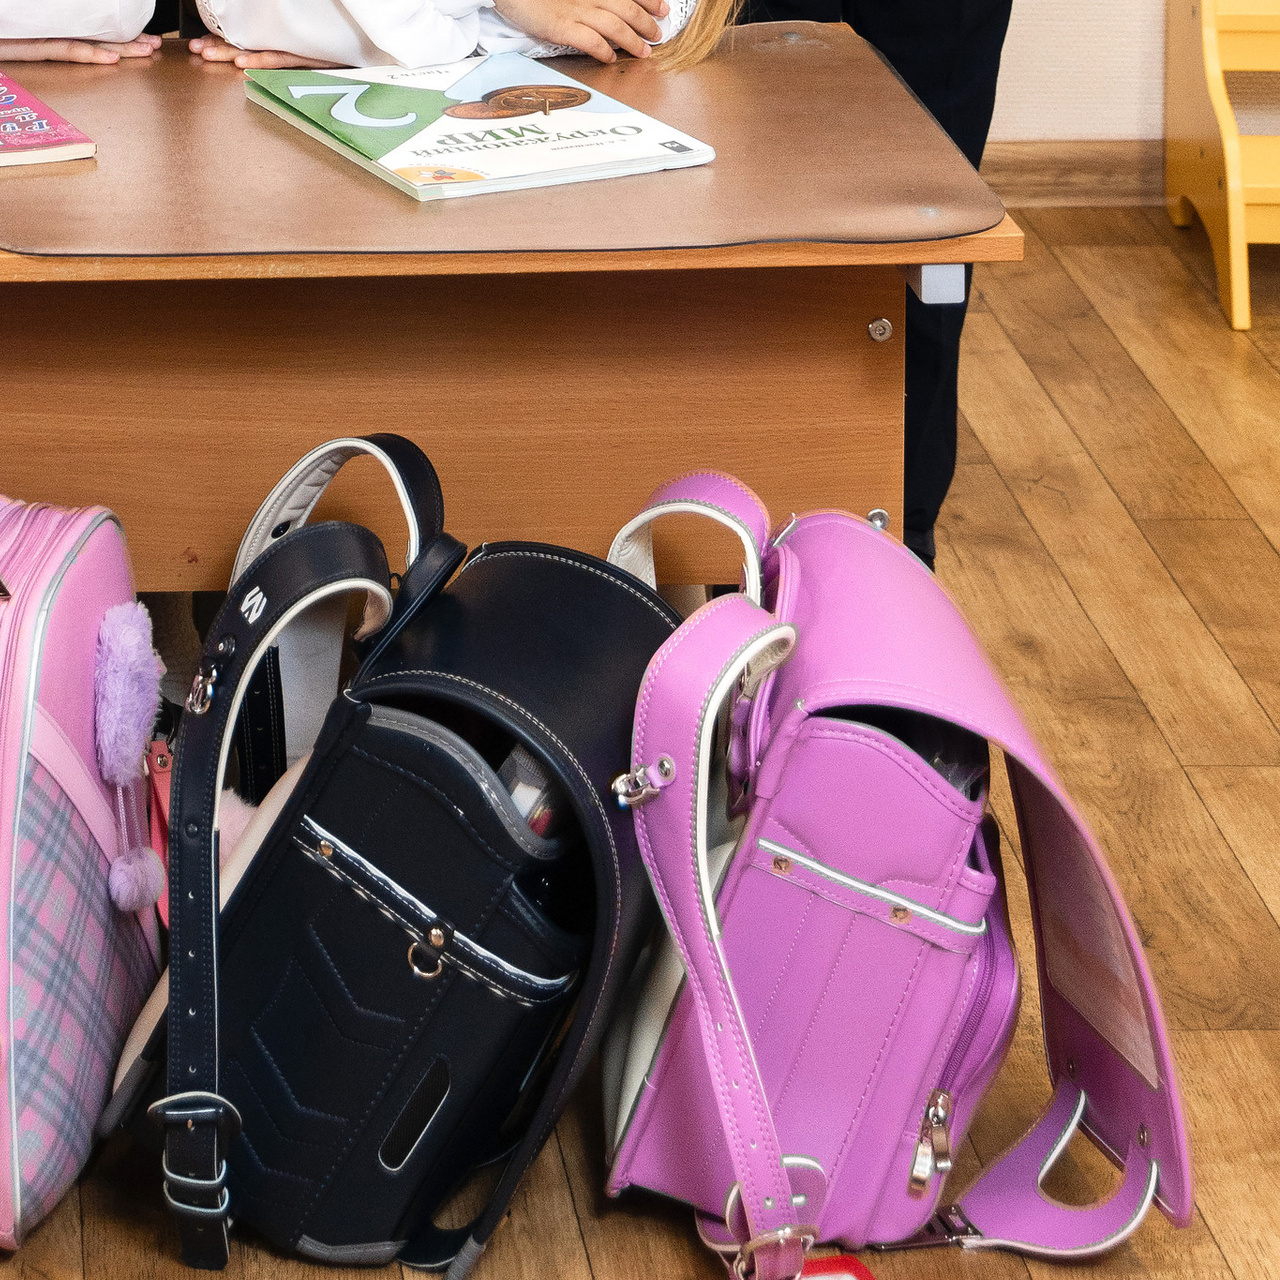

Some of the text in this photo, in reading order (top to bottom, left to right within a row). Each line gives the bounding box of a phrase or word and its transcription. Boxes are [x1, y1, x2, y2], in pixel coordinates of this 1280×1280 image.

[288, 84, 418, 128] 2
[411, 125, 644, 158] Окружающий
[436, 123, 548, 146] МИР
